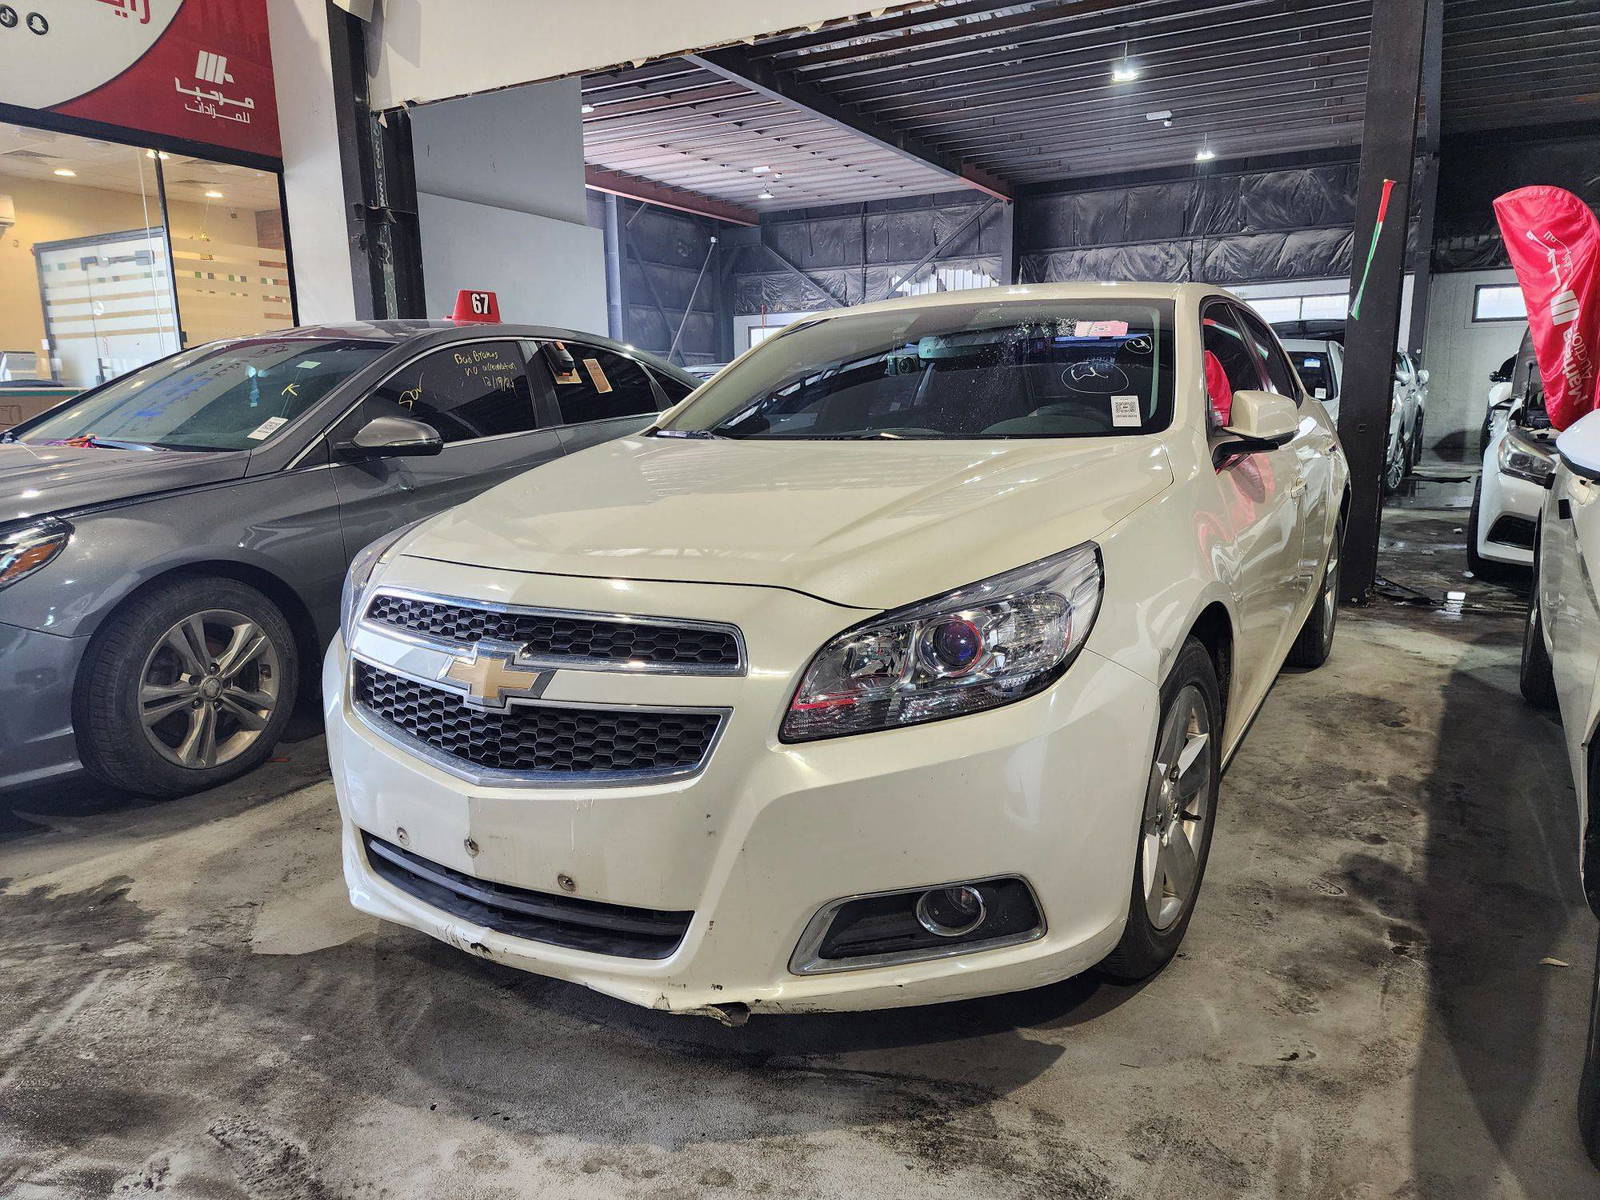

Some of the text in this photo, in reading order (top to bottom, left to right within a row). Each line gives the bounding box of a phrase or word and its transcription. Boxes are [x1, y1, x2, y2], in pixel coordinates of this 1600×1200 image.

[174, 76, 255, 109] مرحبا
[184, 100, 250, 124] للمزادات
[471, 293, 489, 315] 67
